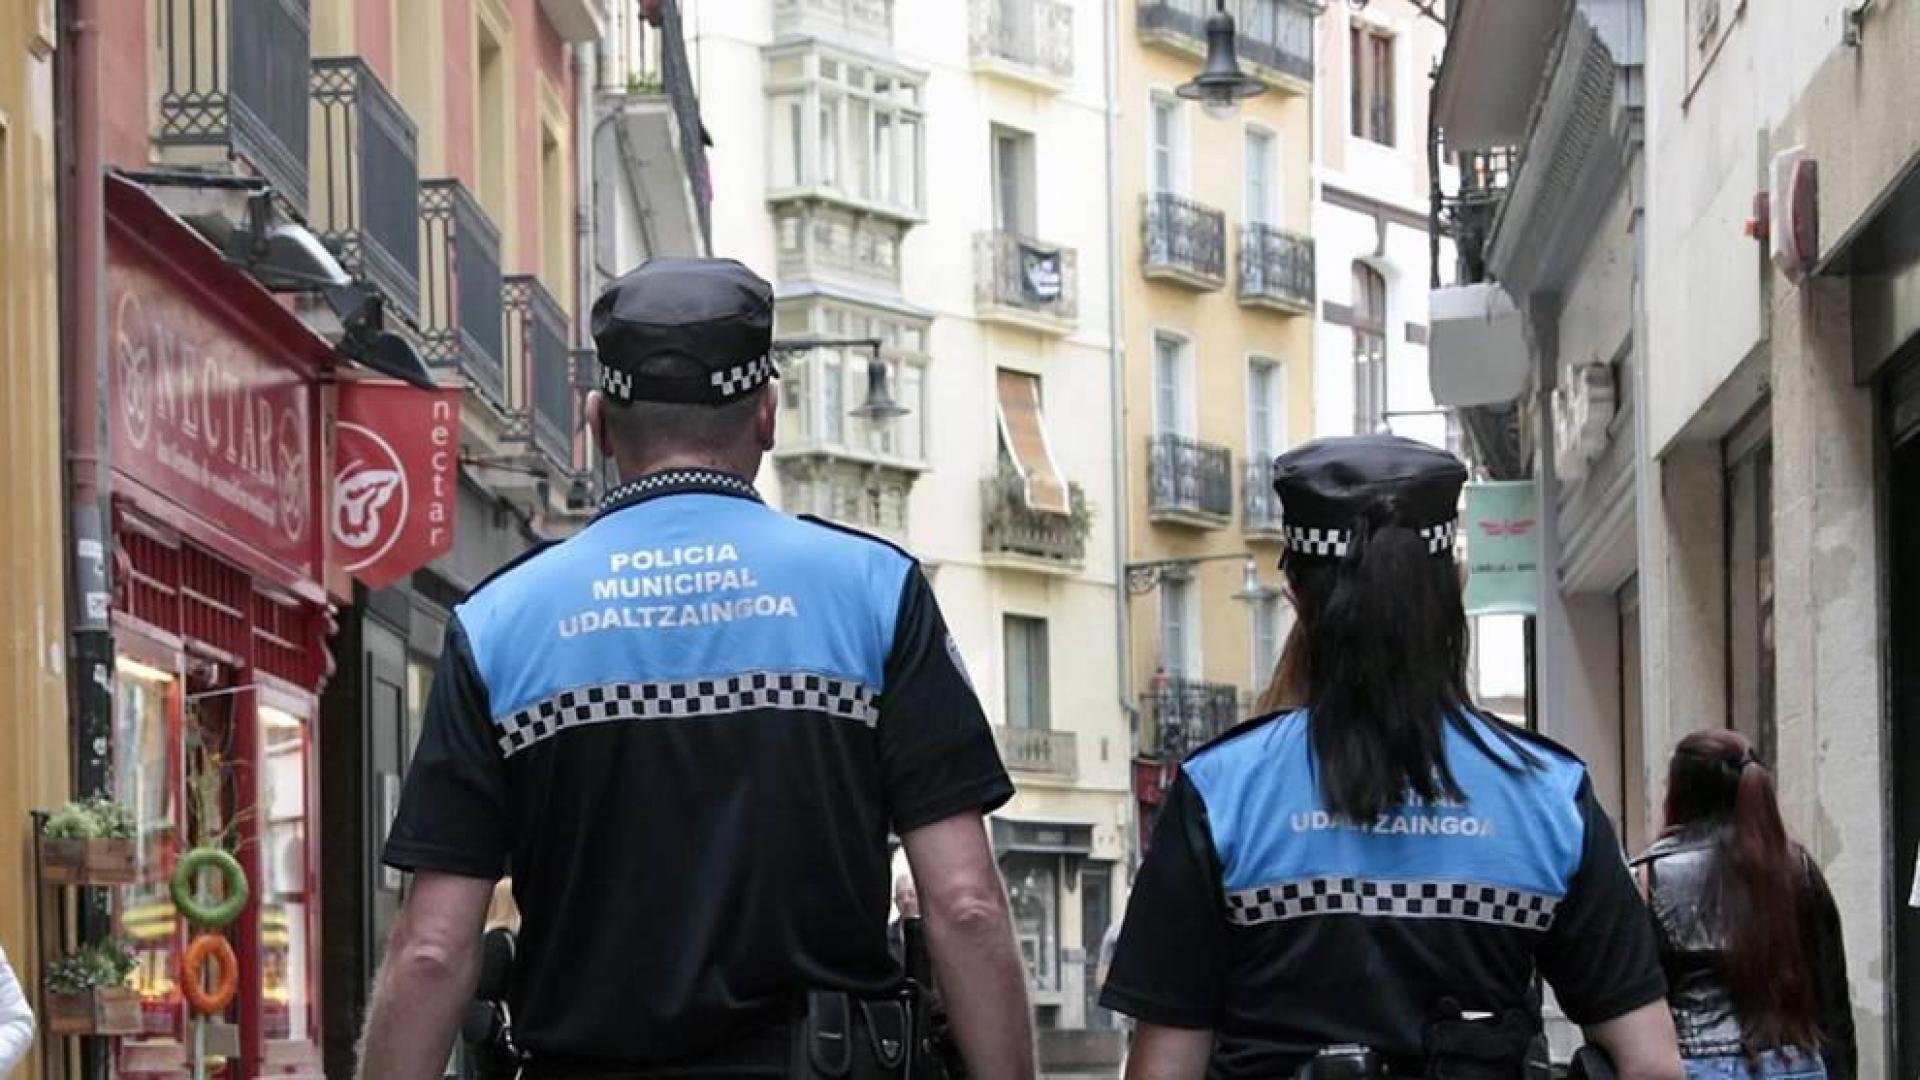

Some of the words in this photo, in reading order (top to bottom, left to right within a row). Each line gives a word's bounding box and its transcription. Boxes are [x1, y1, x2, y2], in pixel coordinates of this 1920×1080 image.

[155, 324, 276, 486] NECTAR
[428, 399, 450, 546] nectar
[610, 543, 738, 572] POLICIA
[592, 567, 758, 600] MUNICIPAL
[560, 594, 798, 637] UDALTZAINGOA
